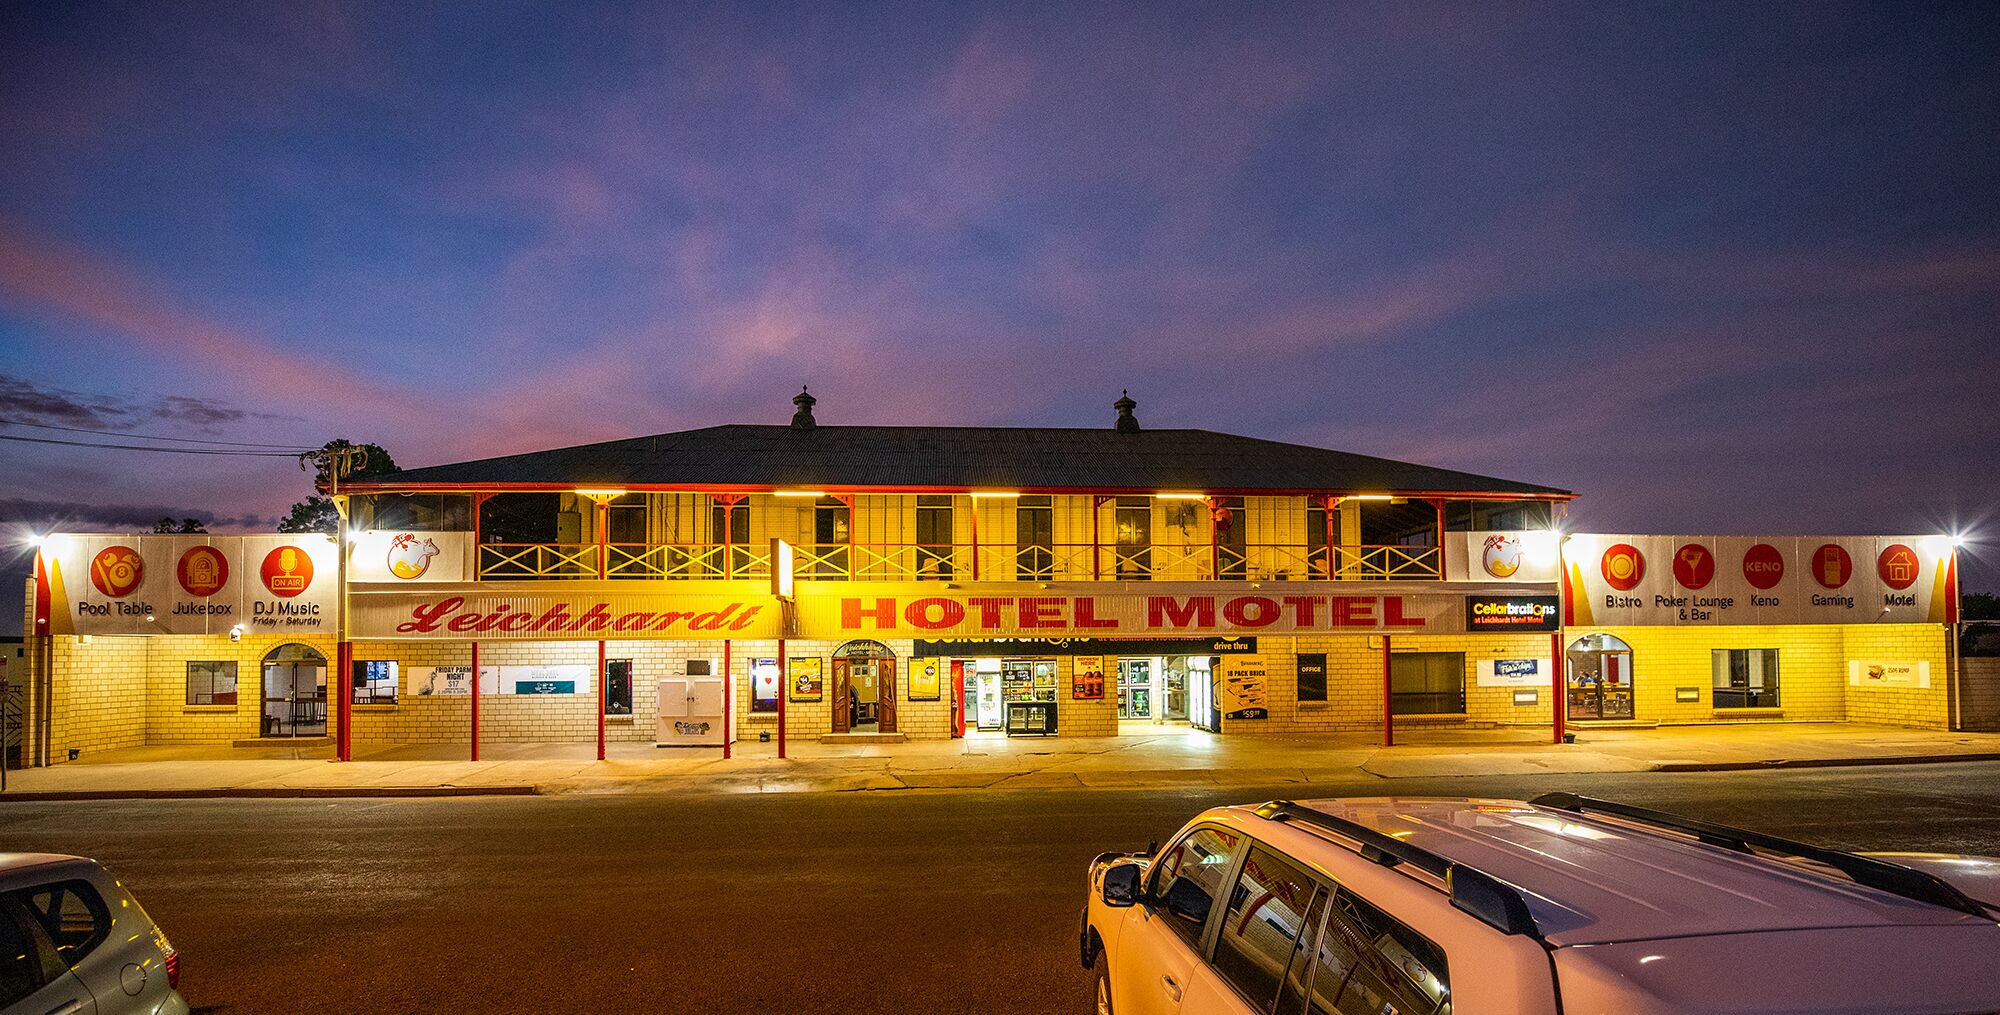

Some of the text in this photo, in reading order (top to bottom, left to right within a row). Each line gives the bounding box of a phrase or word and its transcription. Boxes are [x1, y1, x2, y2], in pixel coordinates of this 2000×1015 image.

[1745, 561, 1781, 572] KENO
[274, 579, 301, 587] ON AIR
[1605, 595, 1642, 608] Bistro
[1655, 595, 1734, 609] Poker Lounge
[1750, 595, 1780, 607] Keno
[1811, 594, 1854, 608] Gaming
[1884, 593, 1916, 607] Motel
[78, 601, 153, 615] Pool Table
[172, 601, 233, 615] Jukebox
[254, 601, 320, 615] DJ Music
[396, 596, 764, 633] Leichhardt
[841, 596, 1426, 630] HOTEL MOTEL
[1473, 602, 1556, 617] Cellarbrations
[1679, 609, 1712, 620] & Bar
[253, 617, 278, 627] Friday
[286, 617, 321, 627] Saturday
[1214, 642, 1249, 650] drive thru
[446, 673, 465, 681] NIGHT
